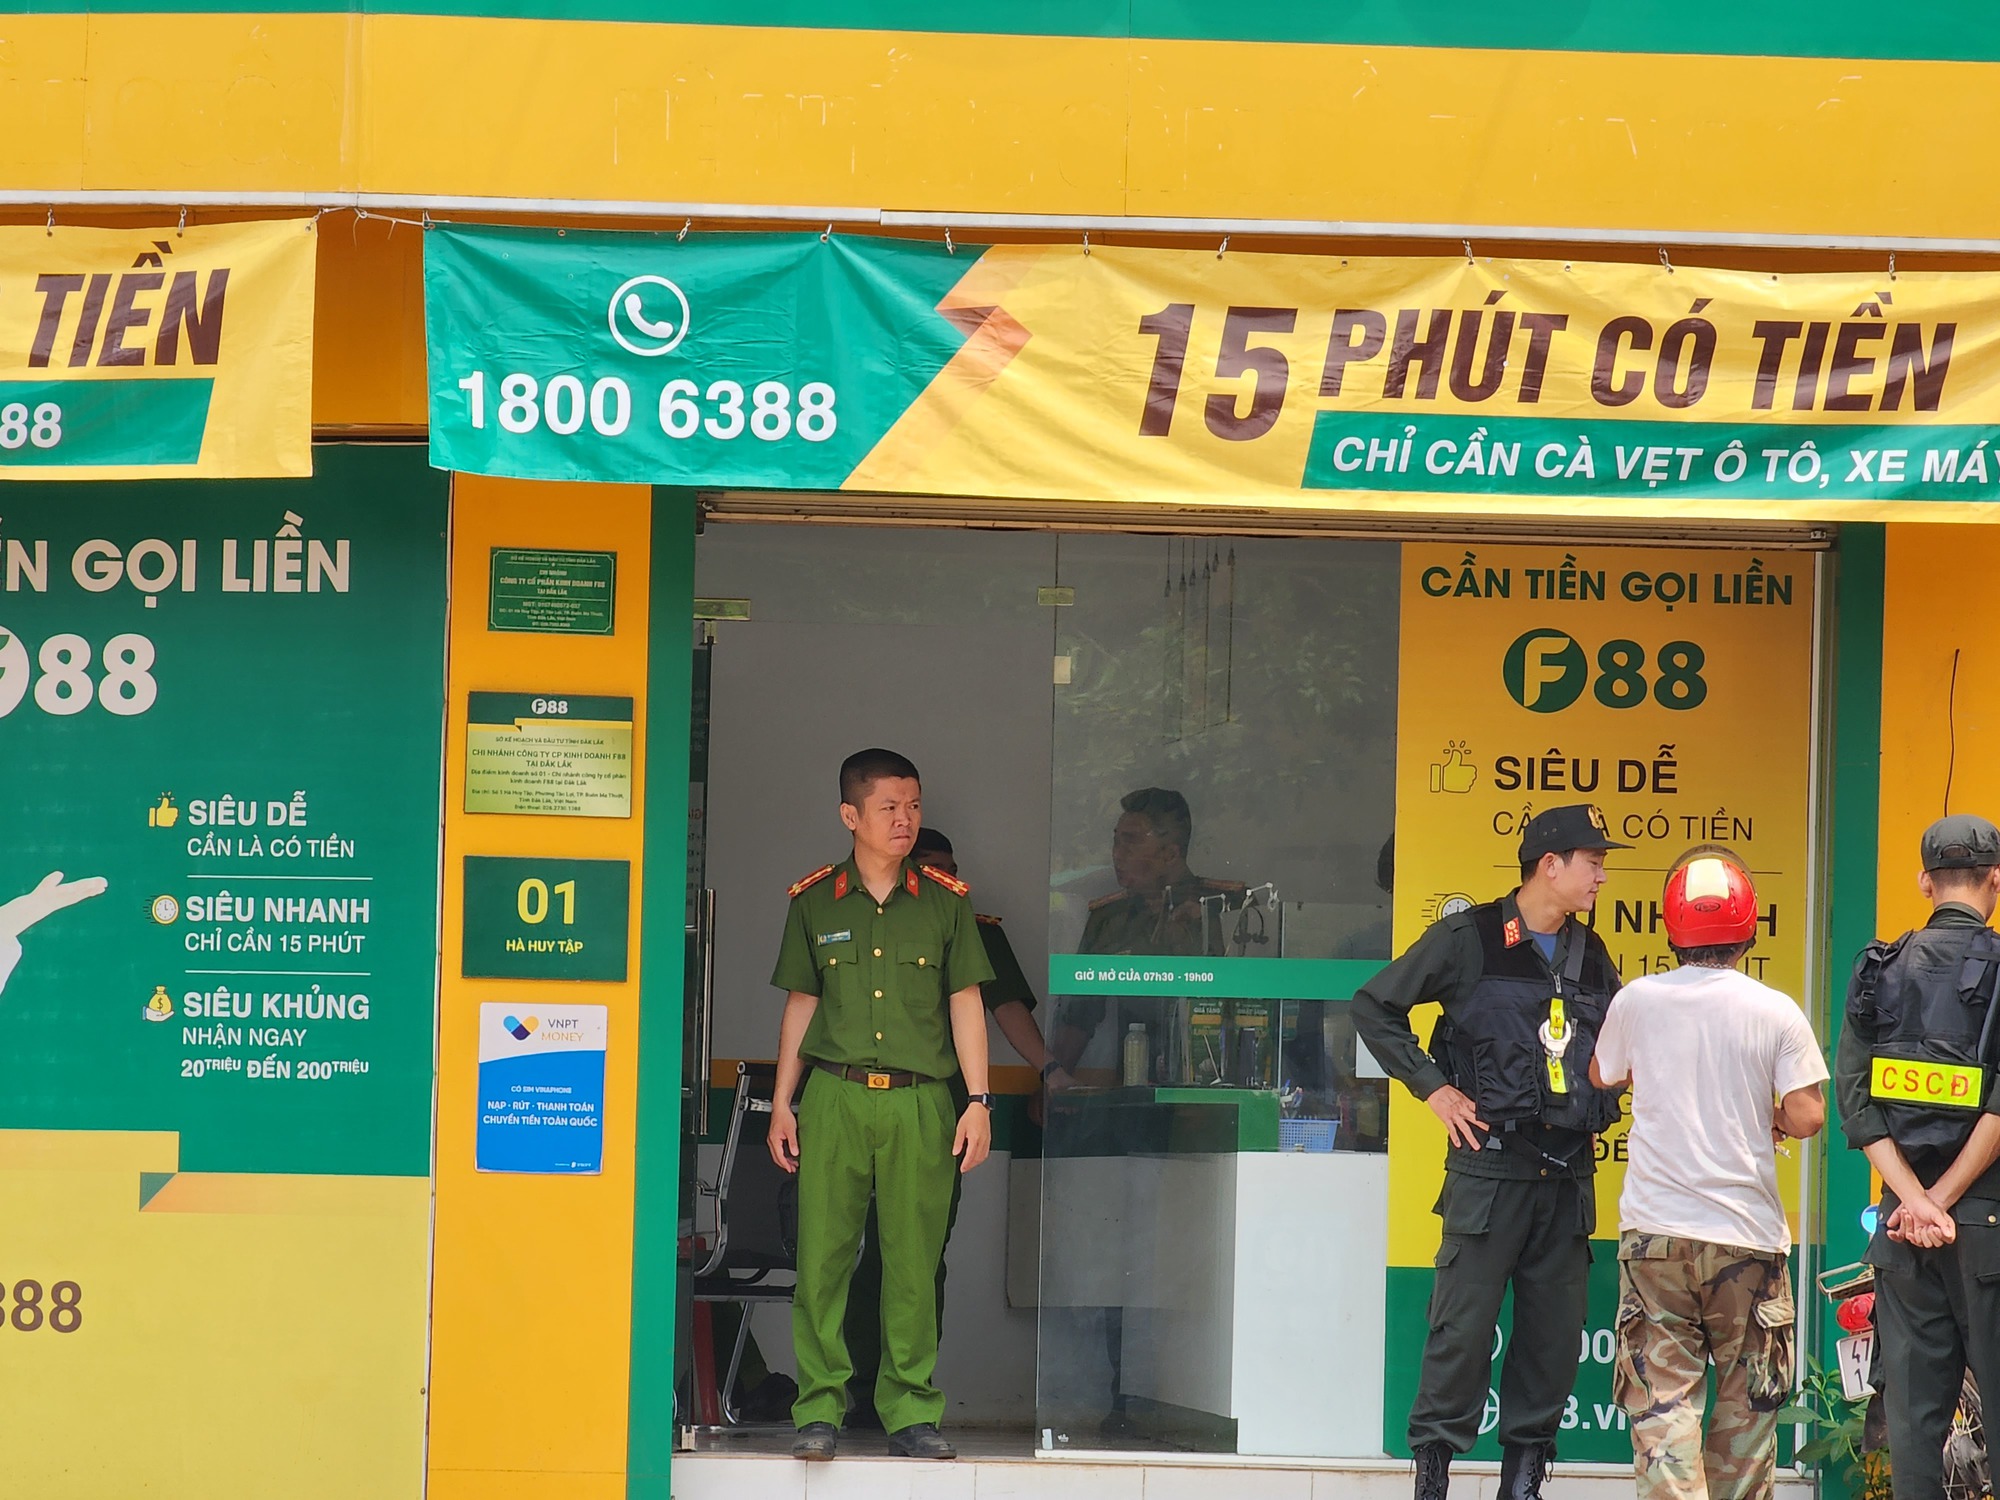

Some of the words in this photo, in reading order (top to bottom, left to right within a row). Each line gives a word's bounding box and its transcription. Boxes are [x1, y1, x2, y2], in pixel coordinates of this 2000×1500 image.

[28, 241, 230, 368] TIỀN
[1138, 303, 1299, 441] 15
[1318, 290, 1568, 403] PHÚT
[1590, 298, 1717, 408] CÓ
[1751, 291, 1957, 412] TIỀN
[458, 371, 632, 436] 1800
[659, 380, 837, 443] 6388
[1333, 425, 1416, 473] CHỈ
[1424, 426, 1521, 477] CẦN
[1534, 435, 1595, 479] CÀ
[1614, 445, 1704, 488] VẸT
[1713, 439, 1748, 482] Ô
[1761, 440, 1830, 489] TÔ,
[1844, 449, 1906, 483] XE
[1922, 440, 2000, 484] MÁ
[71, 538, 197, 608] GỌI
[222, 510, 350, 592] LIỀN
[1421, 551, 1511, 599] CẦN
[1524, 553, 1606, 601] TIỀN
[1621, 570, 1698, 612] GỌI
[1714, 557, 1793, 606] LIỀN
[1502, 627, 1708, 714] F88
[531, 698, 568, 715] F88
[487, 748, 515, 757] NHÁNH
[516, 750, 538, 758] CÔNG
[563, 751, 583, 759] KINH
[584, 752, 611, 760] DOANH
[1494, 747, 1600, 792] SIÊU
[1618, 744, 1678, 793] DỄ
[188, 793, 257, 827] SIÊU
[267, 790, 308, 827] DỄ
[1492, 801, 1532, 836] CẦ
[1622, 808, 1670, 840] CÓ
[1679, 806, 1753, 841] TIỀN
[187, 831, 231, 857] CẦN
[238, 834, 264, 858] LÀ
[270, 835, 301, 858] CÓ
[307, 832, 354, 858] TIỀN
[186, 889, 254, 922] SIÊU
[264, 897, 370, 923] NHANH
[518, 878, 575, 925] 01
[184, 927, 221, 952] CHỈ
[227, 926, 272, 952] CẦN
[280, 934, 302, 953] 15
[308, 931, 365, 953] PHÚT
[506, 937, 525, 952] HÀ
[528, 940, 555, 953] HUY
[558, 938, 584, 955] TẬP
[1074, 968, 1095, 981] GIỜ
[1098, 967, 1116, 981] MỞ
[1118, 967, 1141, 982] CỬA
[1143, 971, 1174, 982] 07h30
[1183, 972, 1214, 982] 19h00
[183, 986, 252, 1018] SIÊU
[262, 984, 370, 1020] KHỦNG
[182, 1023, 242, 1049] NHẬN
[248, 1027, 307, 1047] NGAY
[541, 1032, 584, 1042] MONEY
[547, 1018, 579, 1029] VNPT
[247, 1053, 291, 1079] ĐẾN
[1882, 1066, 1969, 1097] CSCĐ
[510, 1085, 522, 1093] CÓ
[487, 1101, 507, 1111] NẠP
[512, 1100, 530, 1110] RÚT
[537, 1101, 567, 1111] THANH
[568, 1102, 594, 1112] TOÁN
[542, 1115, 568, 1126] TOÀN
[569, 1115, 598, 1127] QUỐC
